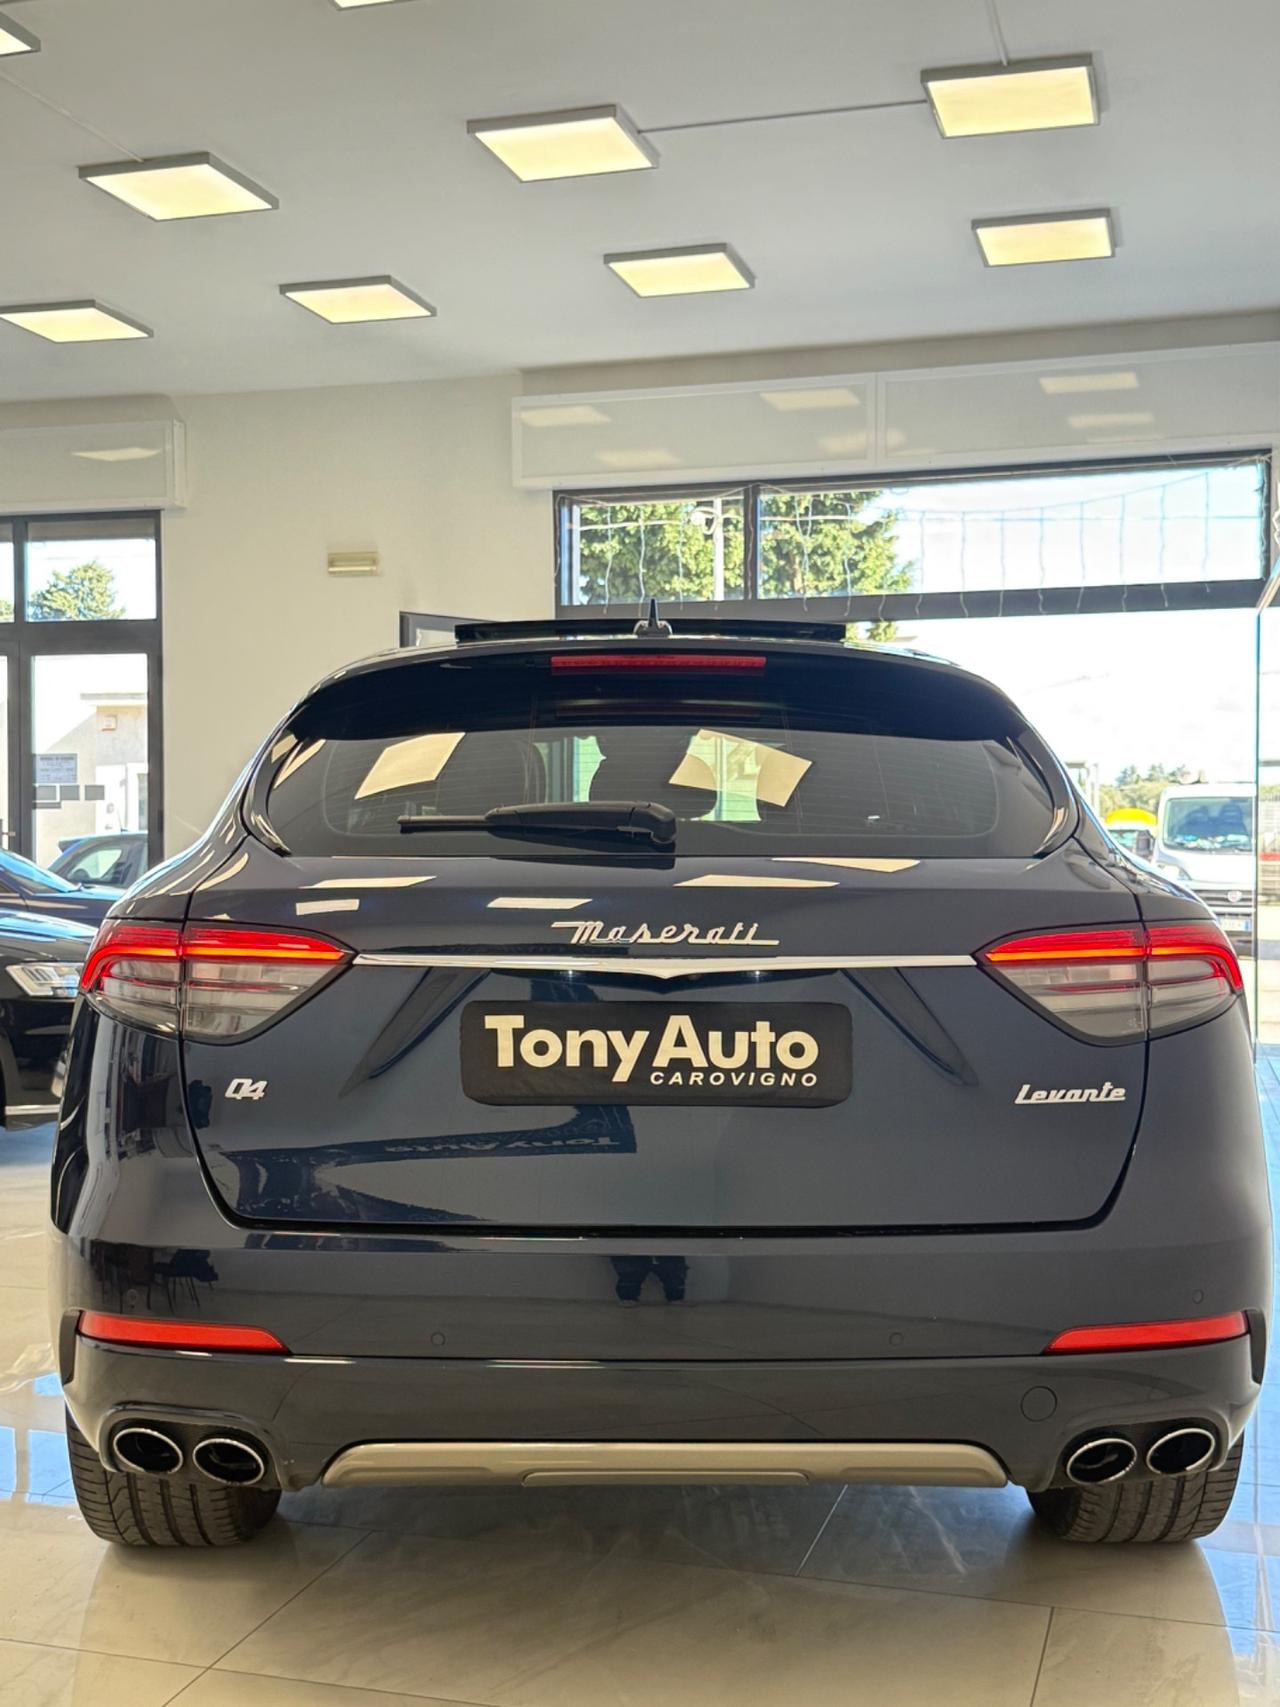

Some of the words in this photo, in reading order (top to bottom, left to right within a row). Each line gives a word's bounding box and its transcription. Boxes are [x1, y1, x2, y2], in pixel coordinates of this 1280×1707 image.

[551, 921, 780, 945] Maserati
[484, 1015, 650, 1082] Tony
[651, 1015, 819, 1069] Auto
[225, 1078, 267, 1100] Q4
[650, 1071, 818, 1087] CAROVIGNO
[1014, 1081, 1126, 1104] Levante
